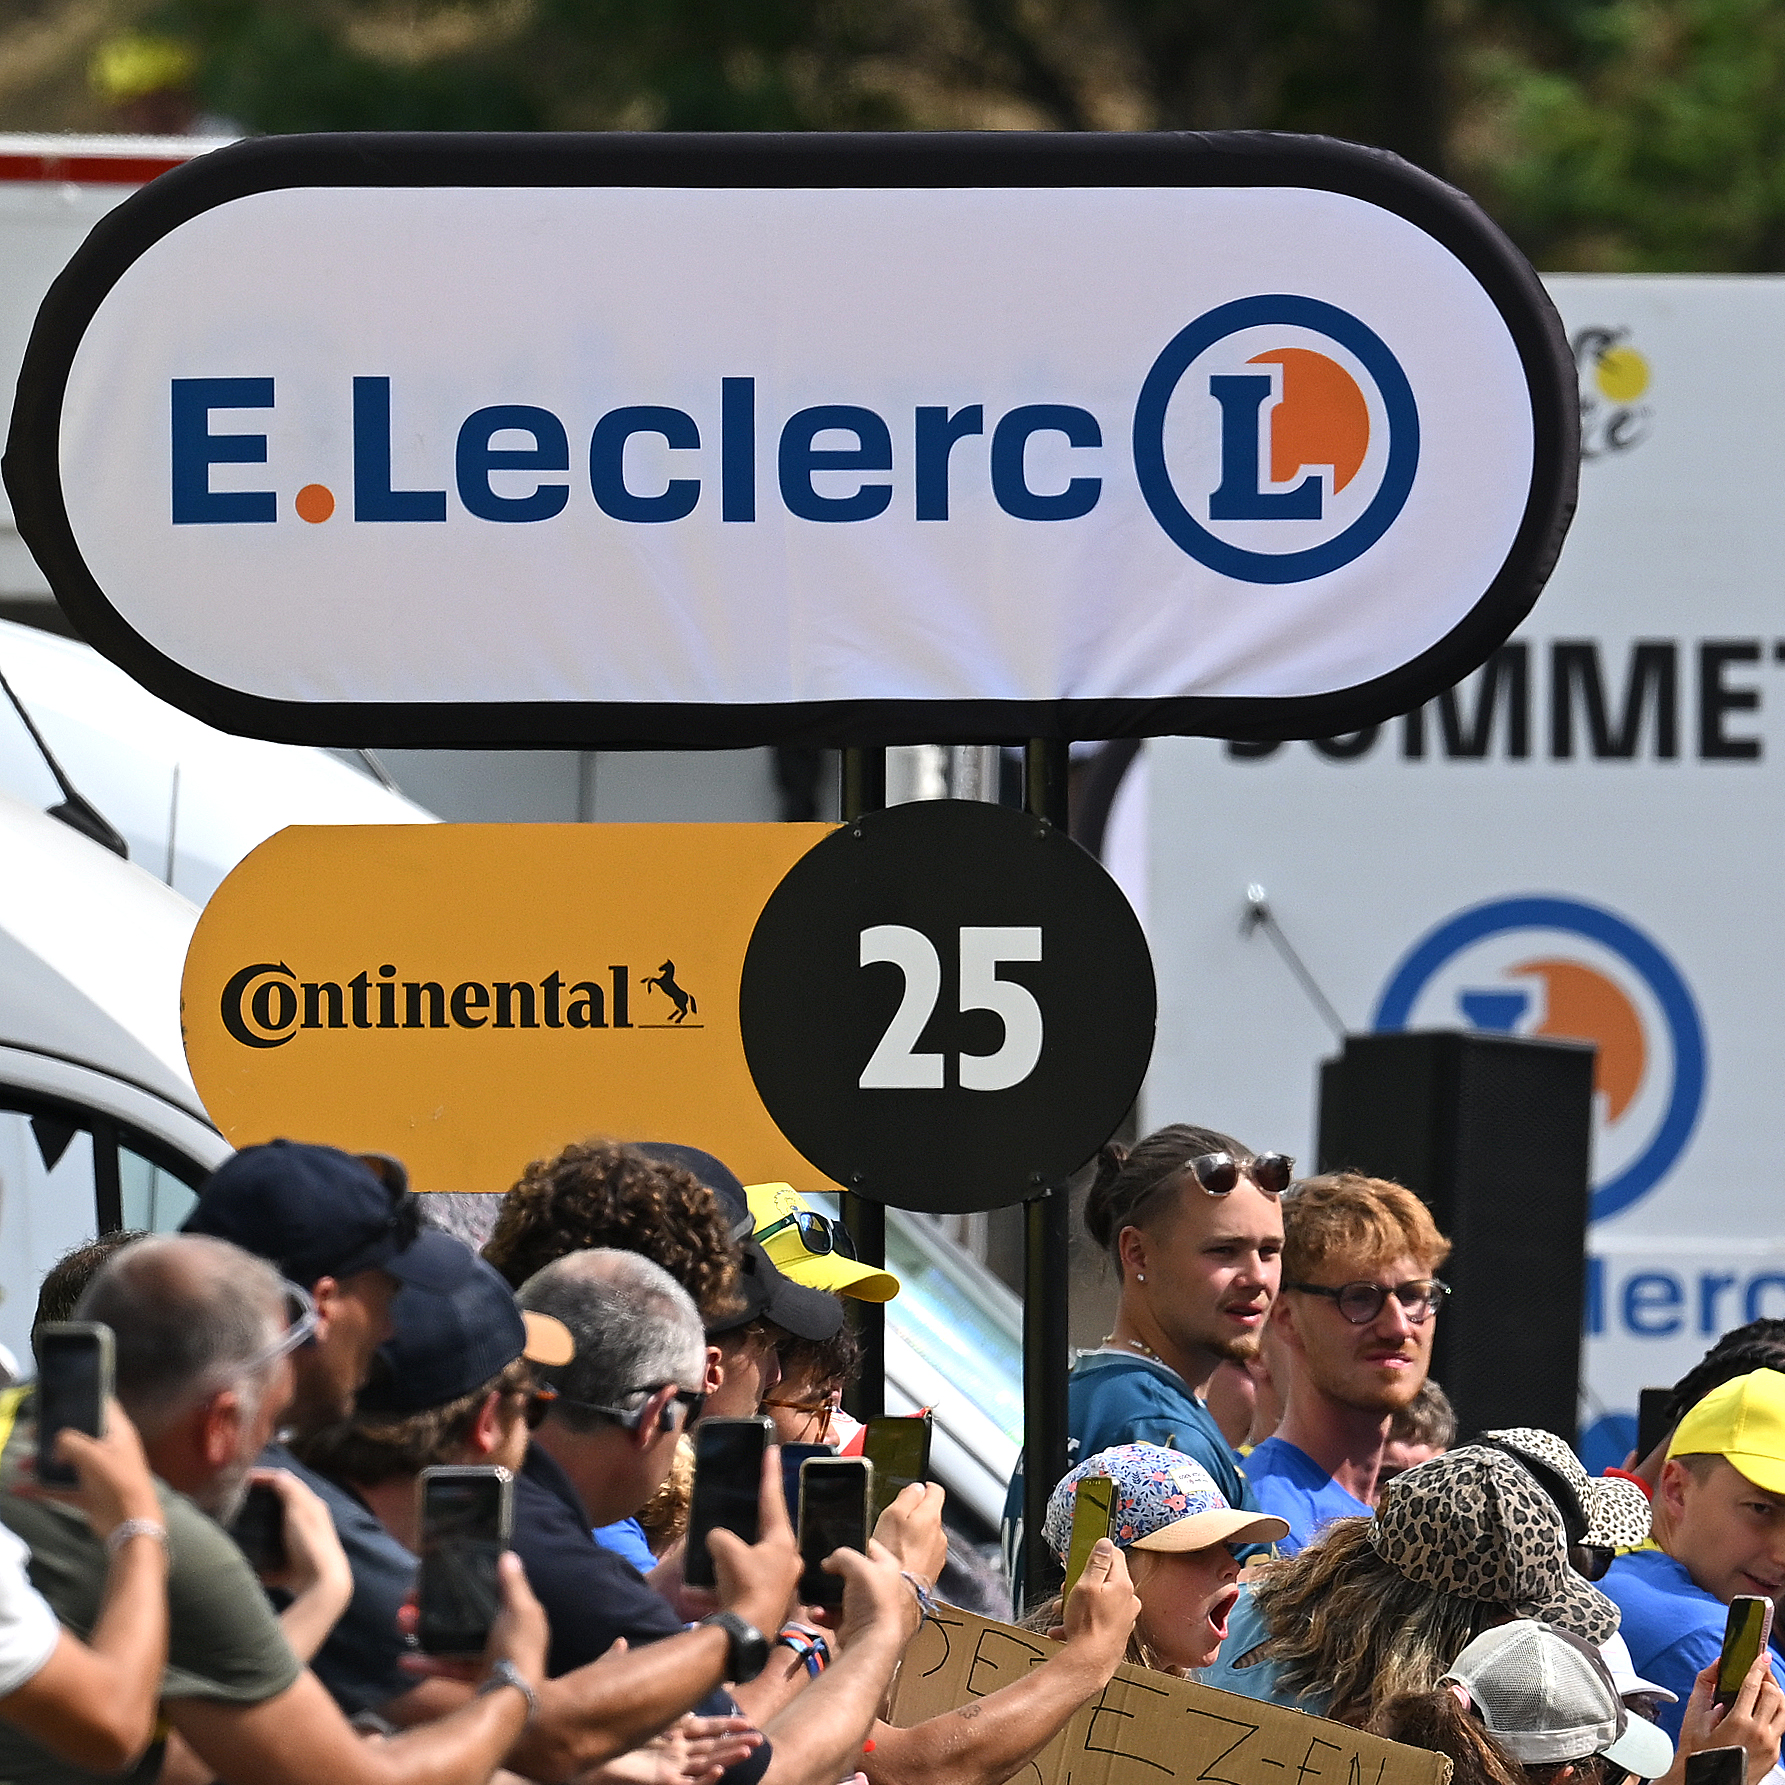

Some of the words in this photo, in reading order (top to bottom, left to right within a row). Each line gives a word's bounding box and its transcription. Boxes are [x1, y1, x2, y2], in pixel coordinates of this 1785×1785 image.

[171, 376, 1103, 525] E.Leclerc
[220, 961, 630, 1049] Continental
[858, 925, 1044, 1093] 25
